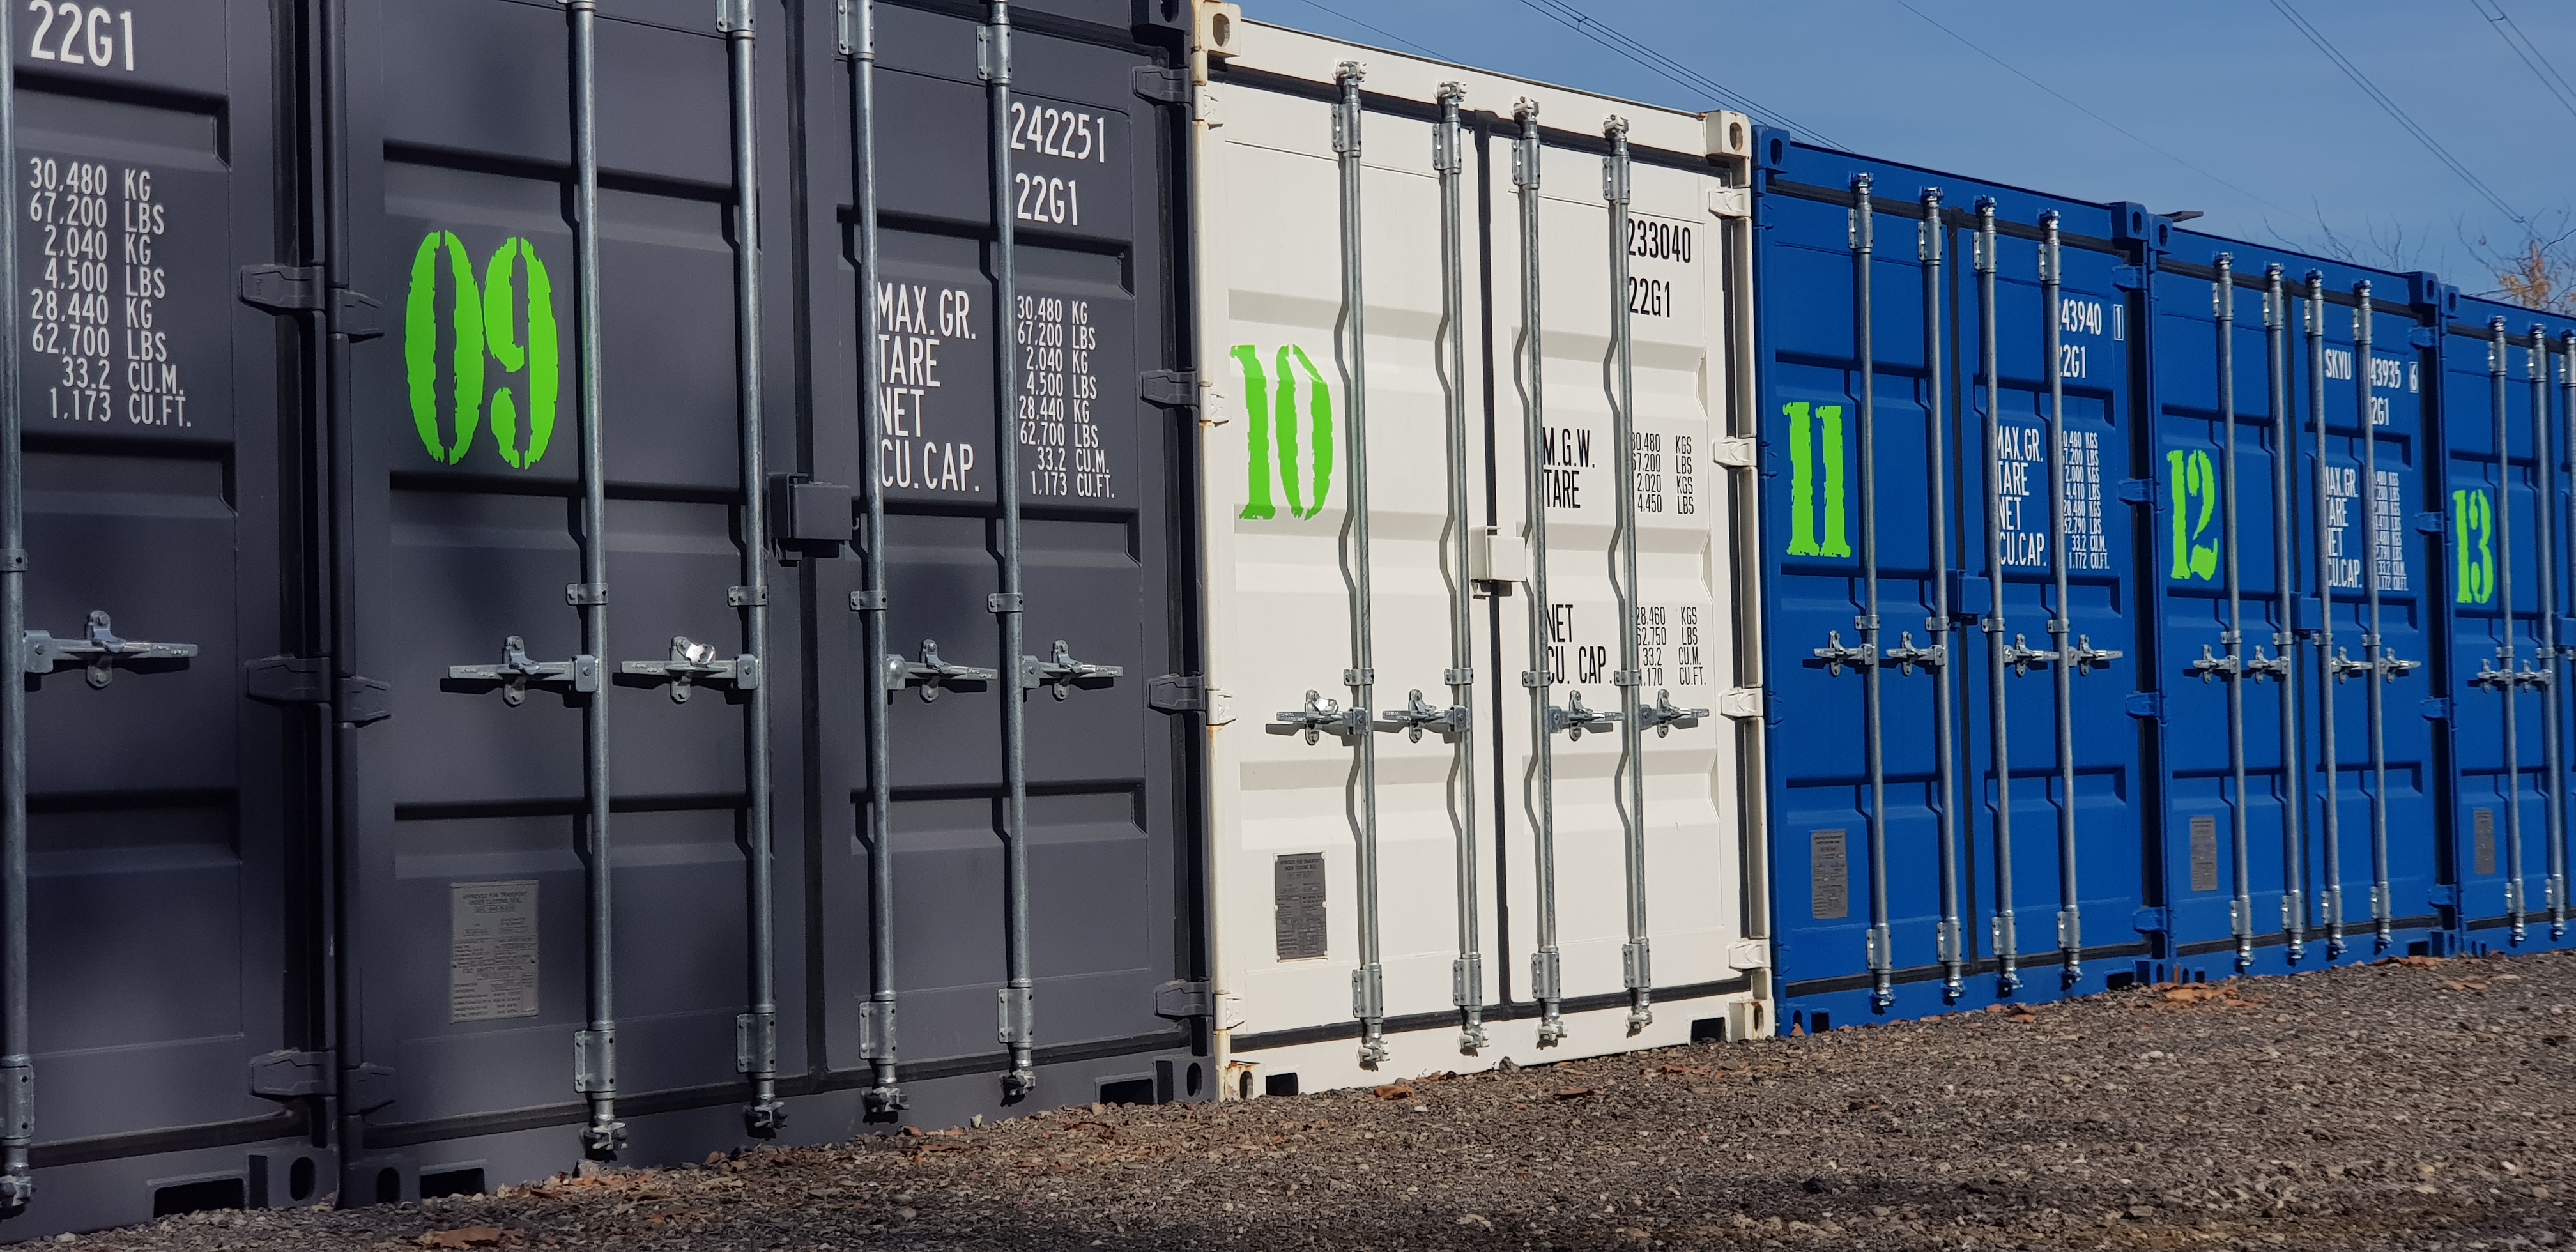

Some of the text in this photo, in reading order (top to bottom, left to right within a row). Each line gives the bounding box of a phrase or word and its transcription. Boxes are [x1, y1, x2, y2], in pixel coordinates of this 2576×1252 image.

[29, 0, 134, 71] 22G1
[1011, 102, 1105, 163] 242251
[125, 169, 151, 201] KG
[1015, 173, 1078, 225] 22G1
[125, 201, 164, 234] LBS
[125, 233, 151, 265] KG
[1628, 218, 1691, 263] 233040
[126, 264, 165, 298] LBS
[1629, 276, 1670, 317] 22G1
[126, 298, 152, 328] KG
[1071, 300, 1087, 324] KG
[2059, 298, 2102, 335] 43940
[127, 329, 167, 362] LBS
[405, 230, 559, 470] 09
[1072, 325, 1096, 350] LBS
[62, 356, 184, 395] 33.2 CU.M.
[878, 334, 940, 387] TARE
[1073, 350, 1088, 374] KG
[2326, 349, 2352, 380] SKYU
[2411, 363, 2418, 392] 6
[1073, 374, 1097, 399] LBS
[128, 393, 192, 427] CU.FT.
[880, 387, 924, 437] NET
[1074, 399, 1089, 423] KG
[1075, 424, 1099, 448] LBS
[1230, 344, 1333, 521] 10
[1543, 427, 1595, 468] M.G.W.
[1676, 435, 1692, 454] KGS
[2085, 432, 2098, 449] KGS
[1037, 447, 1110, 473] 33.2 CU.M.
[1676, 455, 1692, 474] LBS
[2086, 449, 2099, 466] LBS
[1077, 473, 1115, 498] CU.FT.
[1544, 469, 1581, 508] TARE
[1676, 476, 1692, 494] KGS
[1782, 402, 1851, 558] 11
[2087, 467, 2100, 483] KGS
[1677, 496, 1694, 514] LBS
[2089, 484, 2101, 500] LBS
[2089, 501, 2101, 517] KGS
[2167, 450, 2218, 581] 12
[2089, 518, 2102, 535] LBS
[2072, 535, 2087, 551] 33.2
[2453, 489, 2494, 604] 13
[1546, 604, 1573, 642] NET
[1681, 606, 1697, 625] KGS
[1682, 627, 1698, 645] LBS
[1643, 646, 1701, 666] 33.2 CU.M.
[1679, 666, 1706, 685] CU.FT.
